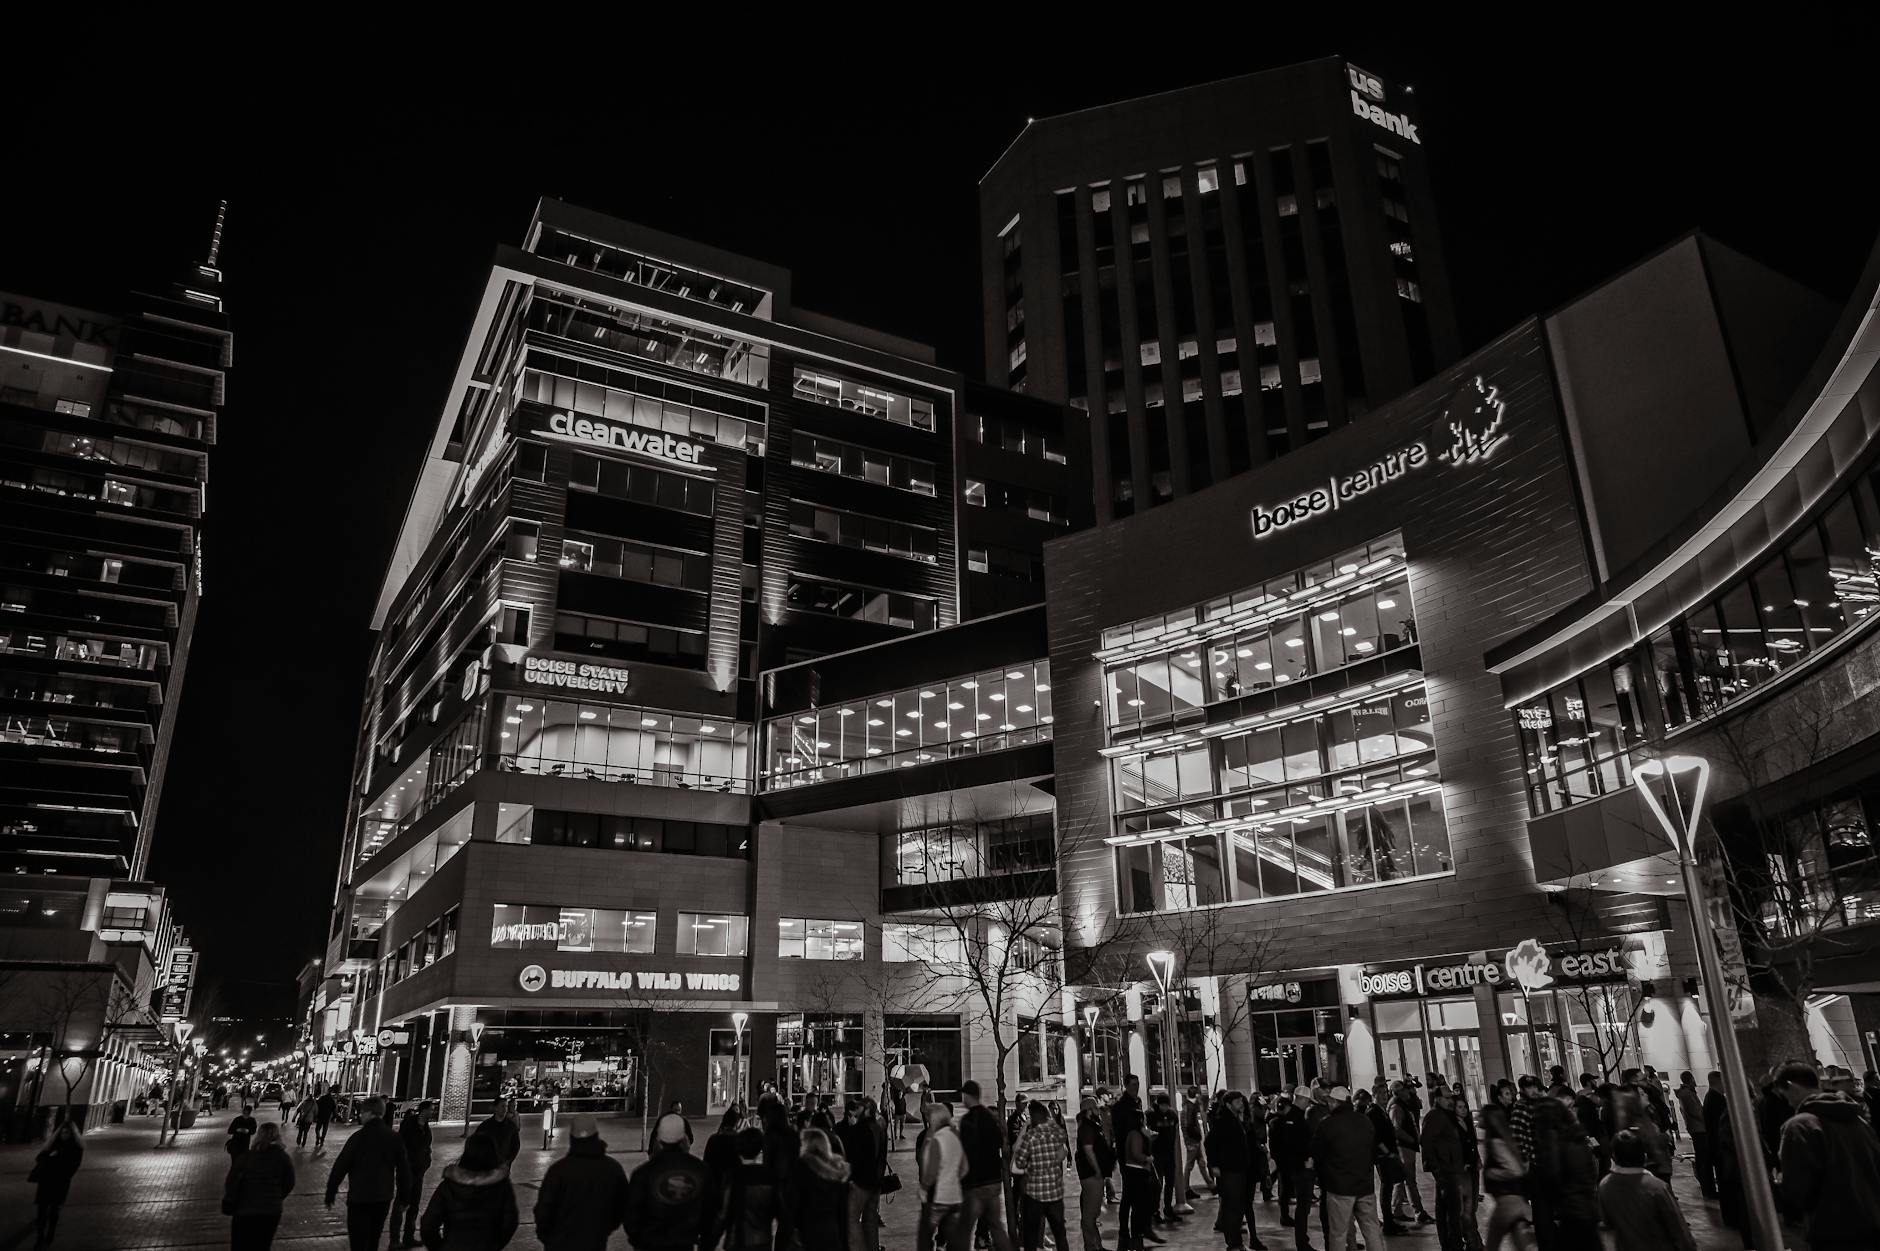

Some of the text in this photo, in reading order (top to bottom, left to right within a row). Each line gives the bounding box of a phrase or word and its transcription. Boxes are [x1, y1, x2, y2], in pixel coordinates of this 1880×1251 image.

[1351, 89, 1421, 145] bank
[2, 302, 113, 346] BANK
[550, 411, 705, 463] clearwater
[1339, 442, 1427, 500] centre
[524, 669, 628, 694] UNIVERSITY
[525, 657, 629, 682] BOISE STATE
[551, 970, 740, 991] BUFFALO WILD WINGS
[1425, 961, 1501, 989] centre
[1561, 948, 1625, 978] east
